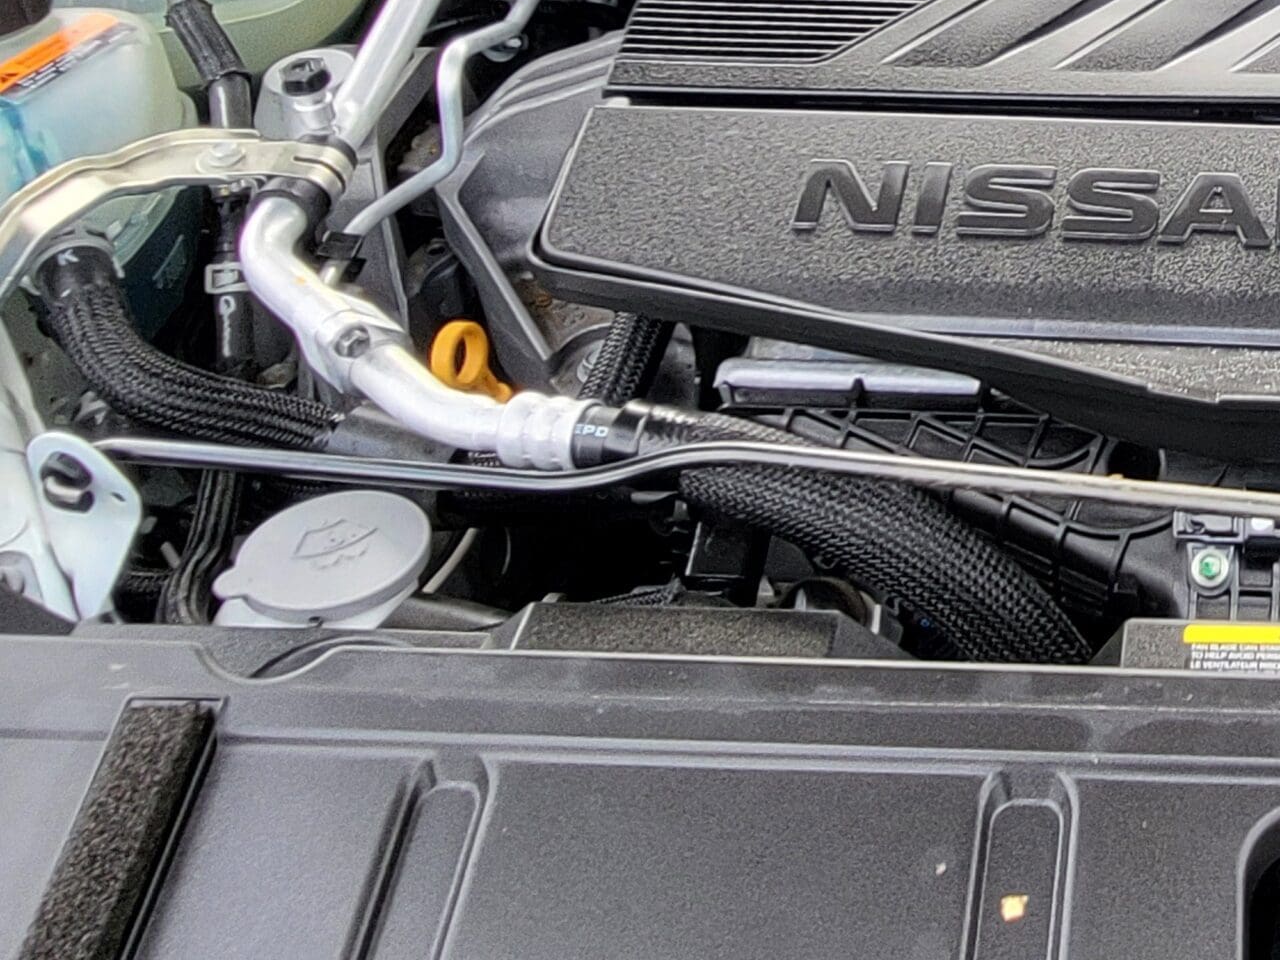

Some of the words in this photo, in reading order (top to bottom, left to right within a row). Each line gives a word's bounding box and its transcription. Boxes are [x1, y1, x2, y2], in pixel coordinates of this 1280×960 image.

[1191, 651, 1203, 660] TO
[1204, 651, 1227, 660] HELP
[1227, 651, 1255, 660] AVOID
[1190, 660, 1202, 669] LE
[1203, 660, 1258, 671] VENTILATEUR
